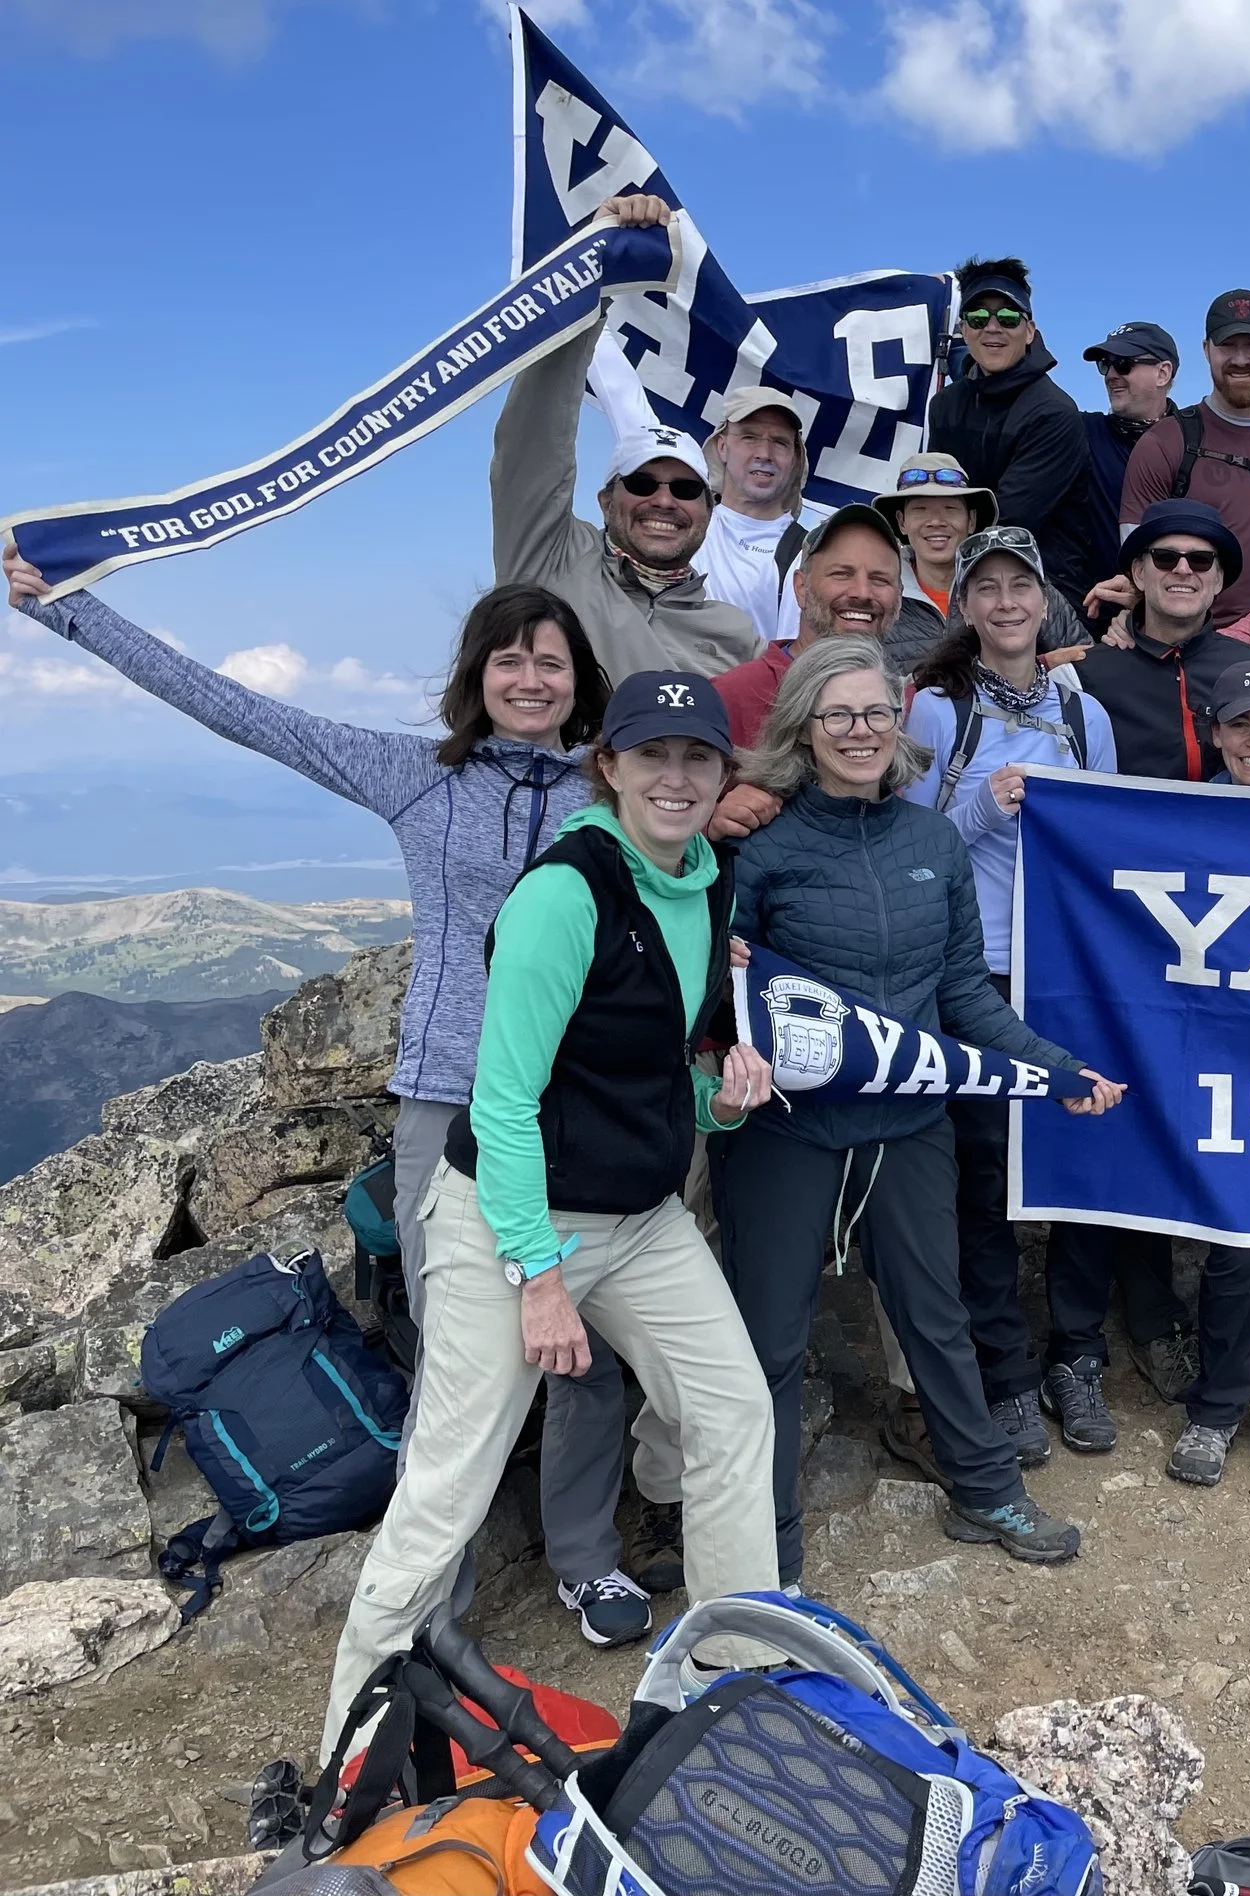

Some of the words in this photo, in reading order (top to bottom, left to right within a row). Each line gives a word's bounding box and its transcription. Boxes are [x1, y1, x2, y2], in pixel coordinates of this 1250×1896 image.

[257, 460, 321, 503] FOR
[318, 371, 438, 468] COUNTRY
[435, 330, 493, 385] AND
[483, 293, 546, 343] FOR
[738, 538, 751, 551] Big
[774, 982, 791, 992] LUX
[791, 982, 801, 991] ET
[802, 984, 838, 1004] VERITAS
[854, 1004, 1050, 1097] YALE
[290, 1457, 309, 1471] TRAIL
[306, 1442, 328, 1460] HYDRO
[326, 1437, 336, 1447] 30
